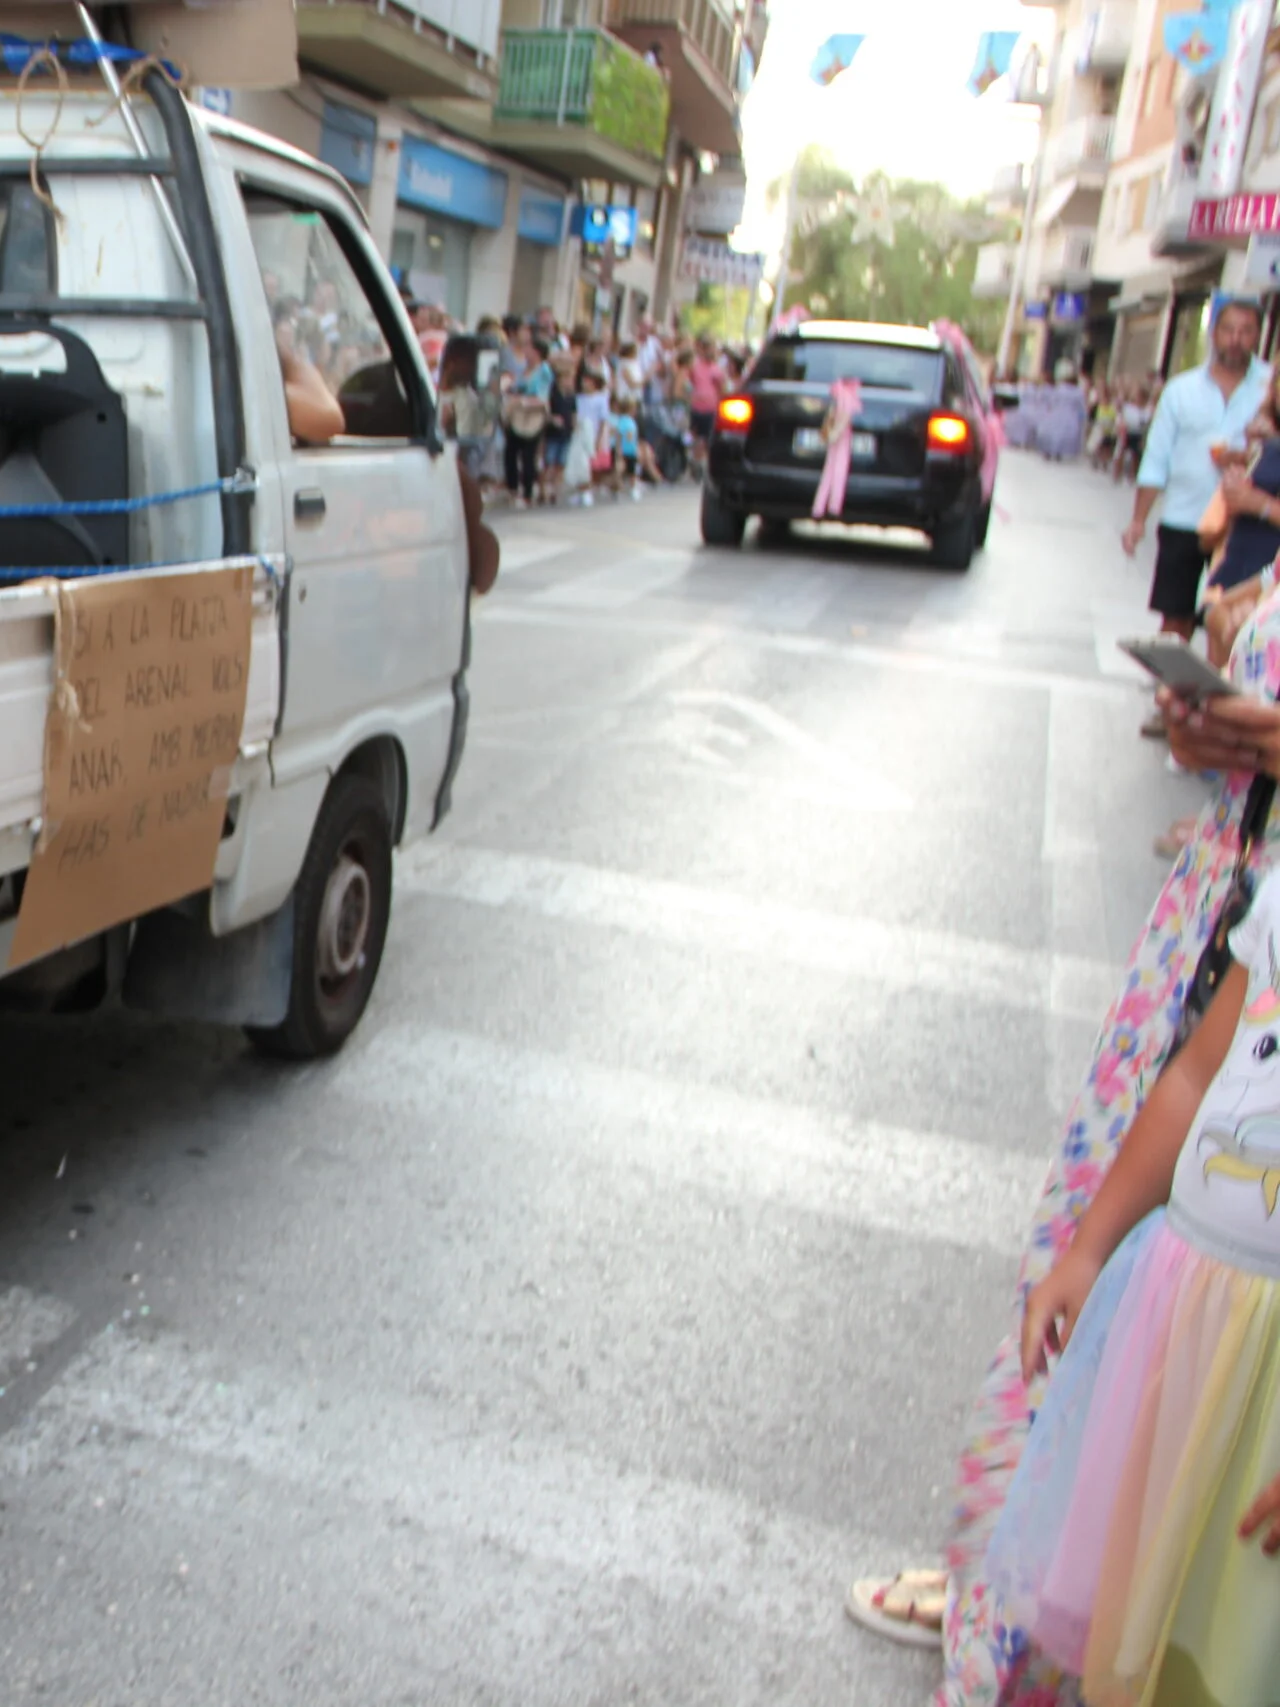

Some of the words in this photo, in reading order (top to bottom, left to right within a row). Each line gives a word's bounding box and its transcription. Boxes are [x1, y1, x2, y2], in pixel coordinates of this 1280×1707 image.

[102, 612, 114, 652] A
[130, 604, 150, 645] LA
[124, 662, 192, 709] ARENAL
[148, 726, 183, 775] AMB
[57, 814, 111, 875] HAS
